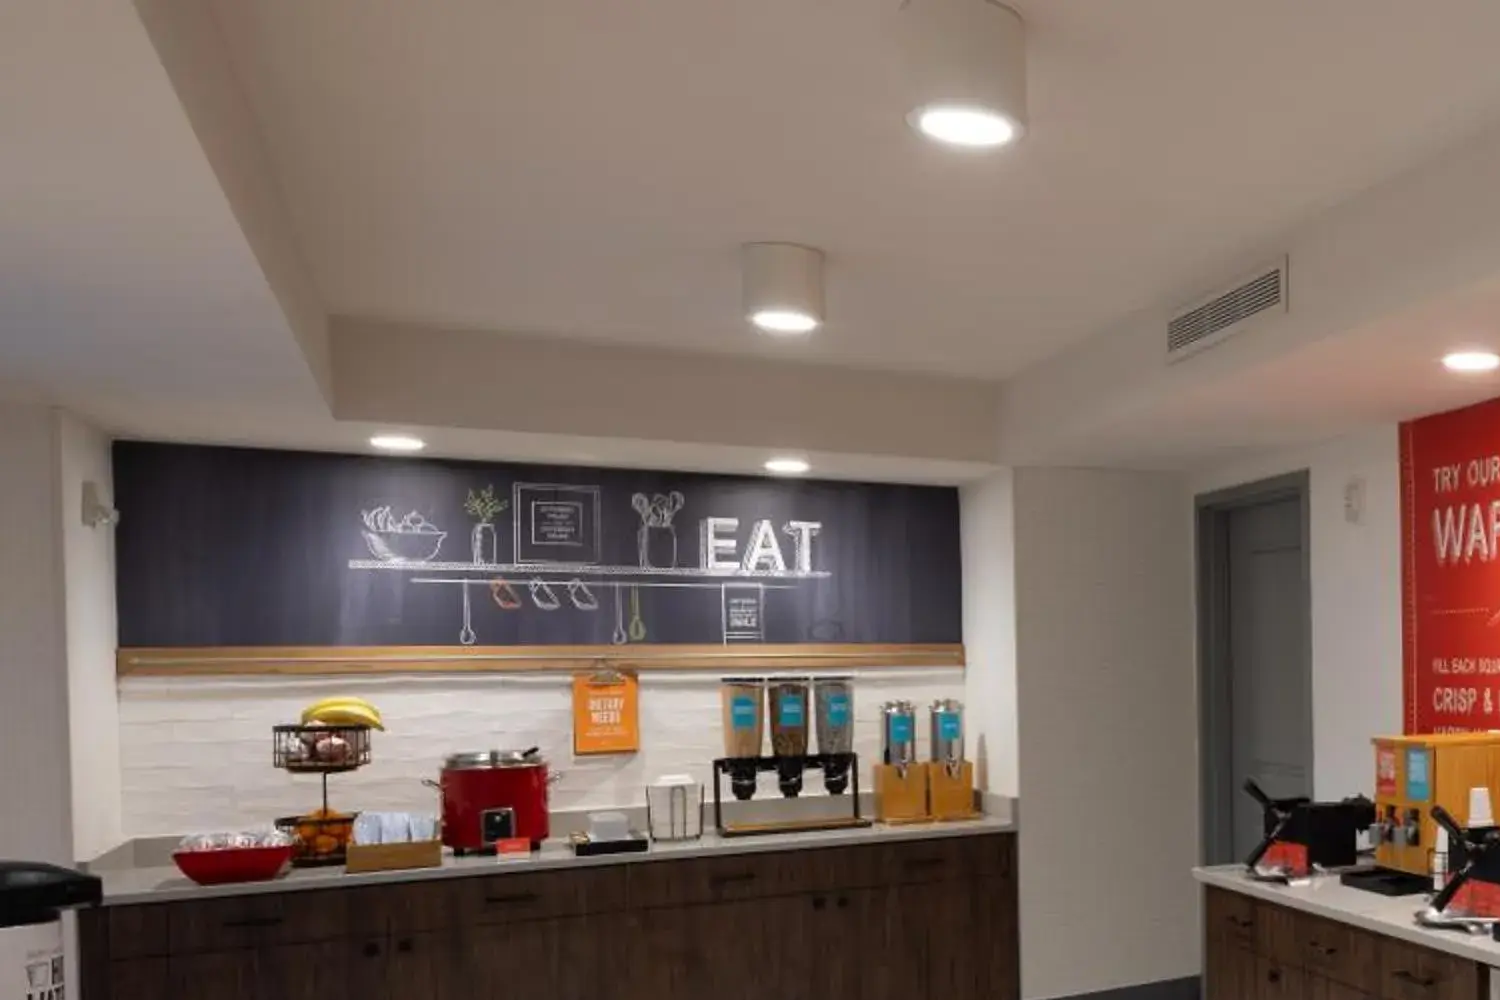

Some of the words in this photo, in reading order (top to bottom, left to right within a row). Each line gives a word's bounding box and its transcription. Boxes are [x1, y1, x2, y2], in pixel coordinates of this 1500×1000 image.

[1433, 464, 1461, 493] TRY
[699, 516, 823, 574] EAT
[1433, 687, 1478, 716] CRISP
[1483, 687, 1494, 715] &
